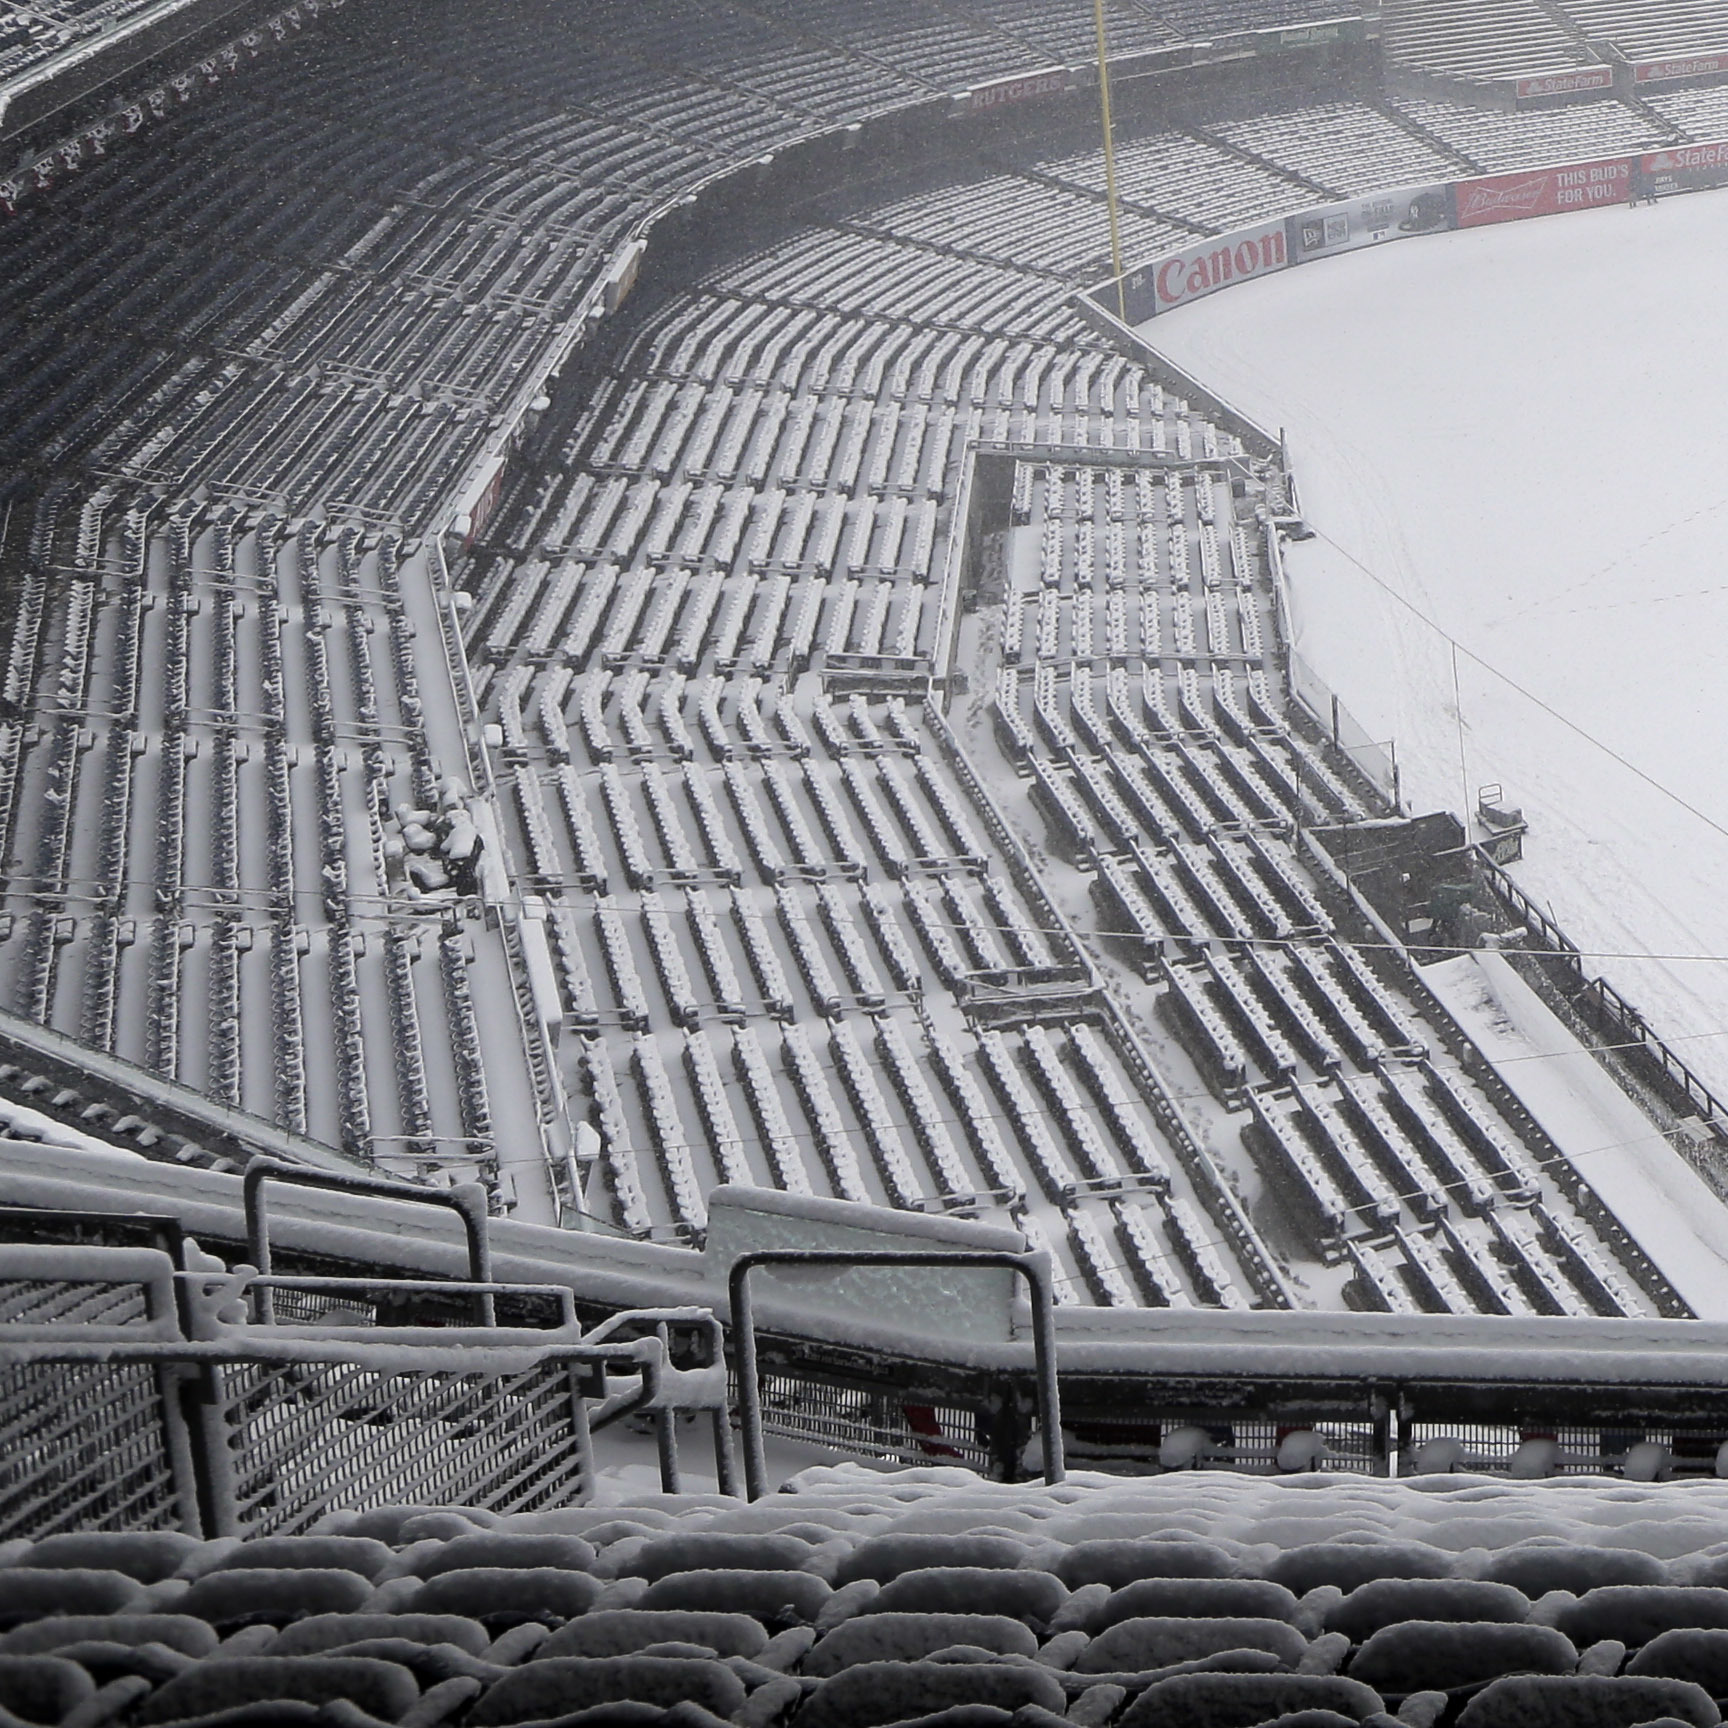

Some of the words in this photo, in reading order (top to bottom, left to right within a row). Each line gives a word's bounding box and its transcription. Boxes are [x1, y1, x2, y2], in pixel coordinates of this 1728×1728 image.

[1556, 170, 1585, 187] THIS
[1591, 165, 1629, 181] BUD'S
[1557, 190, 1582, 204] FOR
[1588, 184, 1616, 201] YOU.
[1157, 230, 1286, 303] Canon
